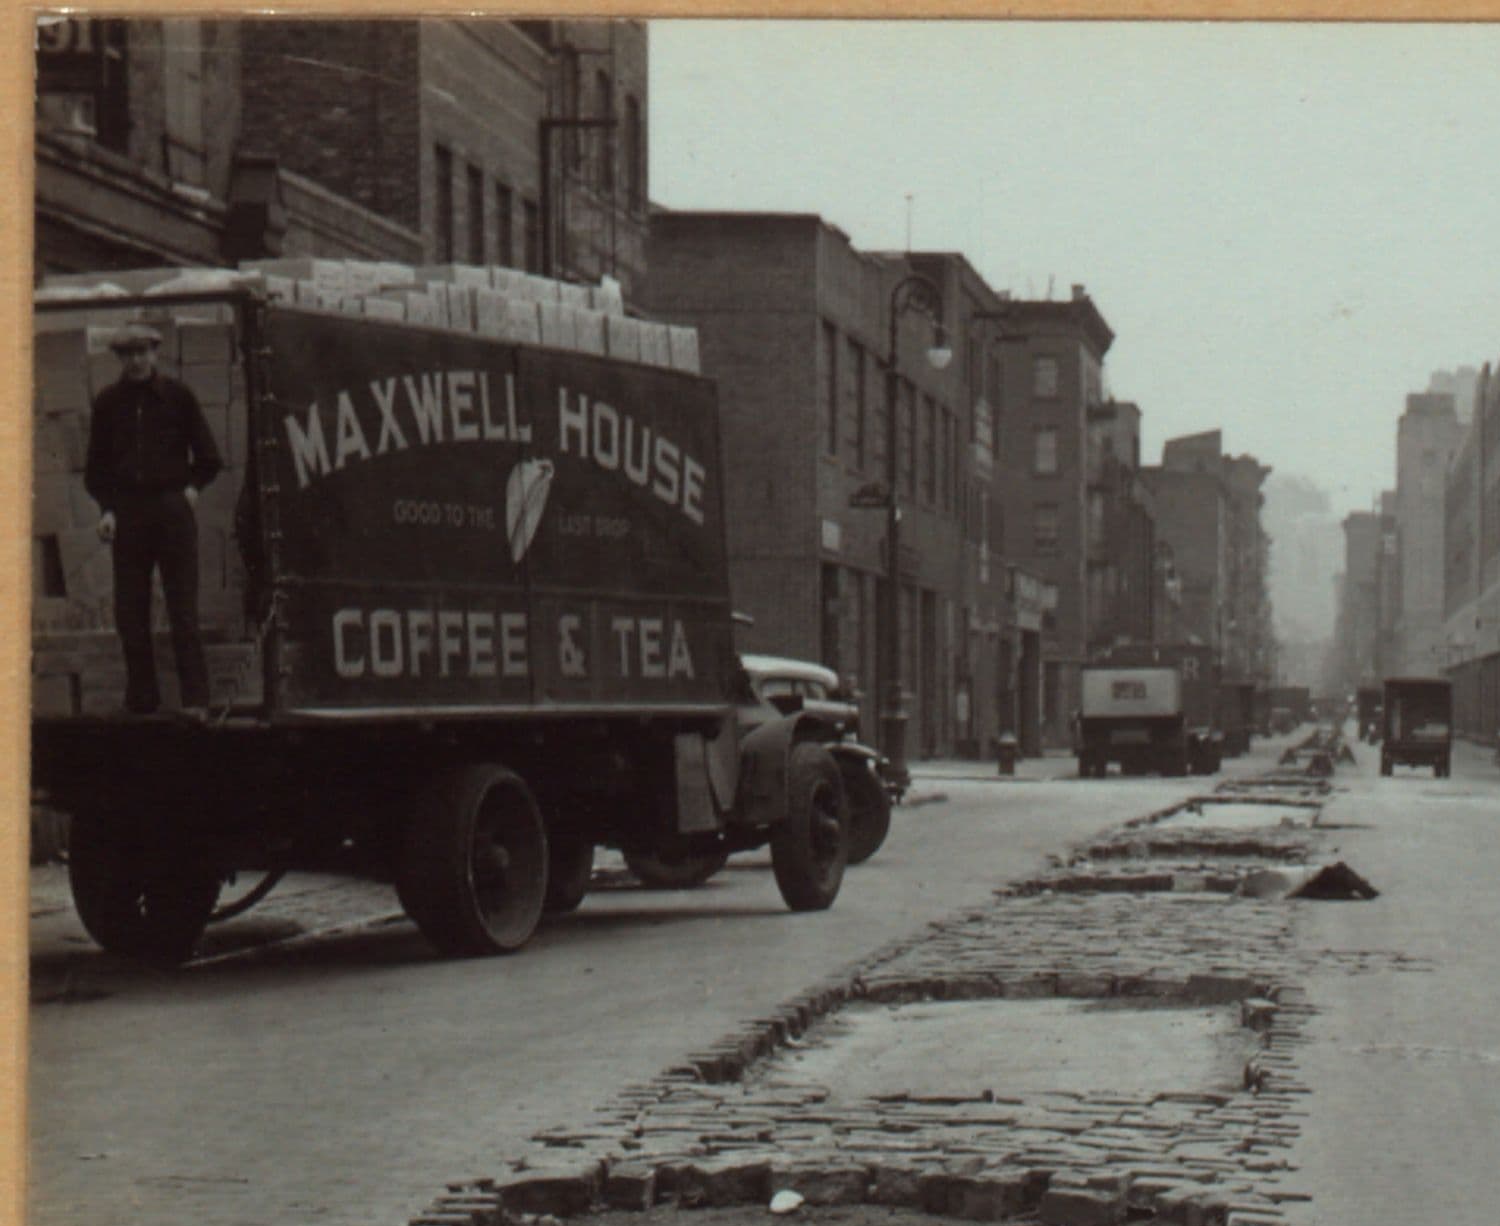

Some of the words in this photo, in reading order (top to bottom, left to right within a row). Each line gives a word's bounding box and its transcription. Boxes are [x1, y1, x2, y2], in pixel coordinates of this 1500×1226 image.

[284, 371, 531, 488] MAXWELL
[559, 387, 706, 525] HOUSE
[393, 499, 441, 525] GOOD
[446, 502, 464, 528] TO
[333, 609, 529, 678] COFFEE
[559, 614, 587, 677] &
[611, 617, 695, 681] TEA
